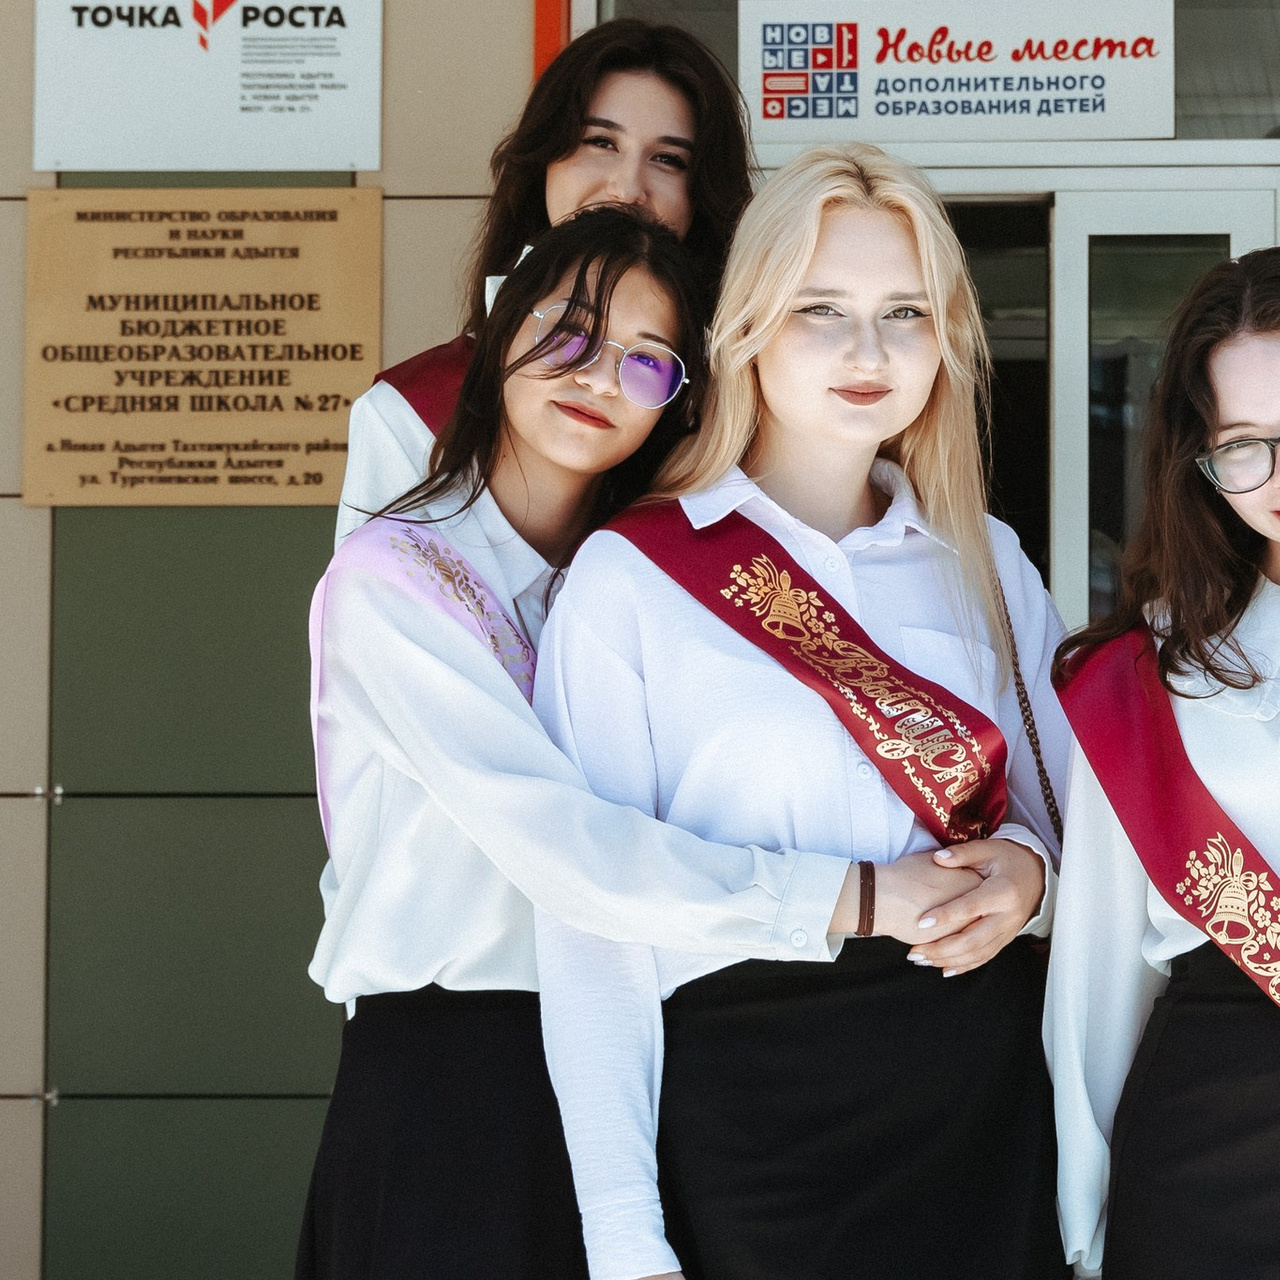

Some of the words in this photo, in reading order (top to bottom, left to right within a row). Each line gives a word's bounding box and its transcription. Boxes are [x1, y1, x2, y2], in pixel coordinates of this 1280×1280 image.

[71, 6, 181, 28] ТОЧКА
[242, 6, 346, 28] РОСТА
[875, 26, 998, 64] Новые
[1011, 36, 1160, 62] места
[875, 75, 1105, 95] ДОПОЛНИТЕЛЬНОГО
[875, 99, 1030, 116] ОБРАЗОВАНИЯ
[1037, 94, 1105, 116] ДЕТЕЙ
[217, 210, 338, 222] ОБРАЗОВАНИЯ
[169, 229, 181, 240] И
[187, 229, 243, 240] НАУКИ
[113, 247, 225, 260] РЕСПУБЛИКИ
[232, 247, 299, 260] АДЫГЕЯ
[87, 293, 320, 313] МУНИЦИПАЛЬНОЕ
[121, 319, 286, 338] БЮДЖЕТНОЕ
[42, 344, 363, 363] ОБЩЕОБРАЗОВАТЕЛЬНОЕ
[115, 370, 290, 388] УЧРЕЖДЕНИЕ
[190, 395, 284, 412] ШКОЛА
